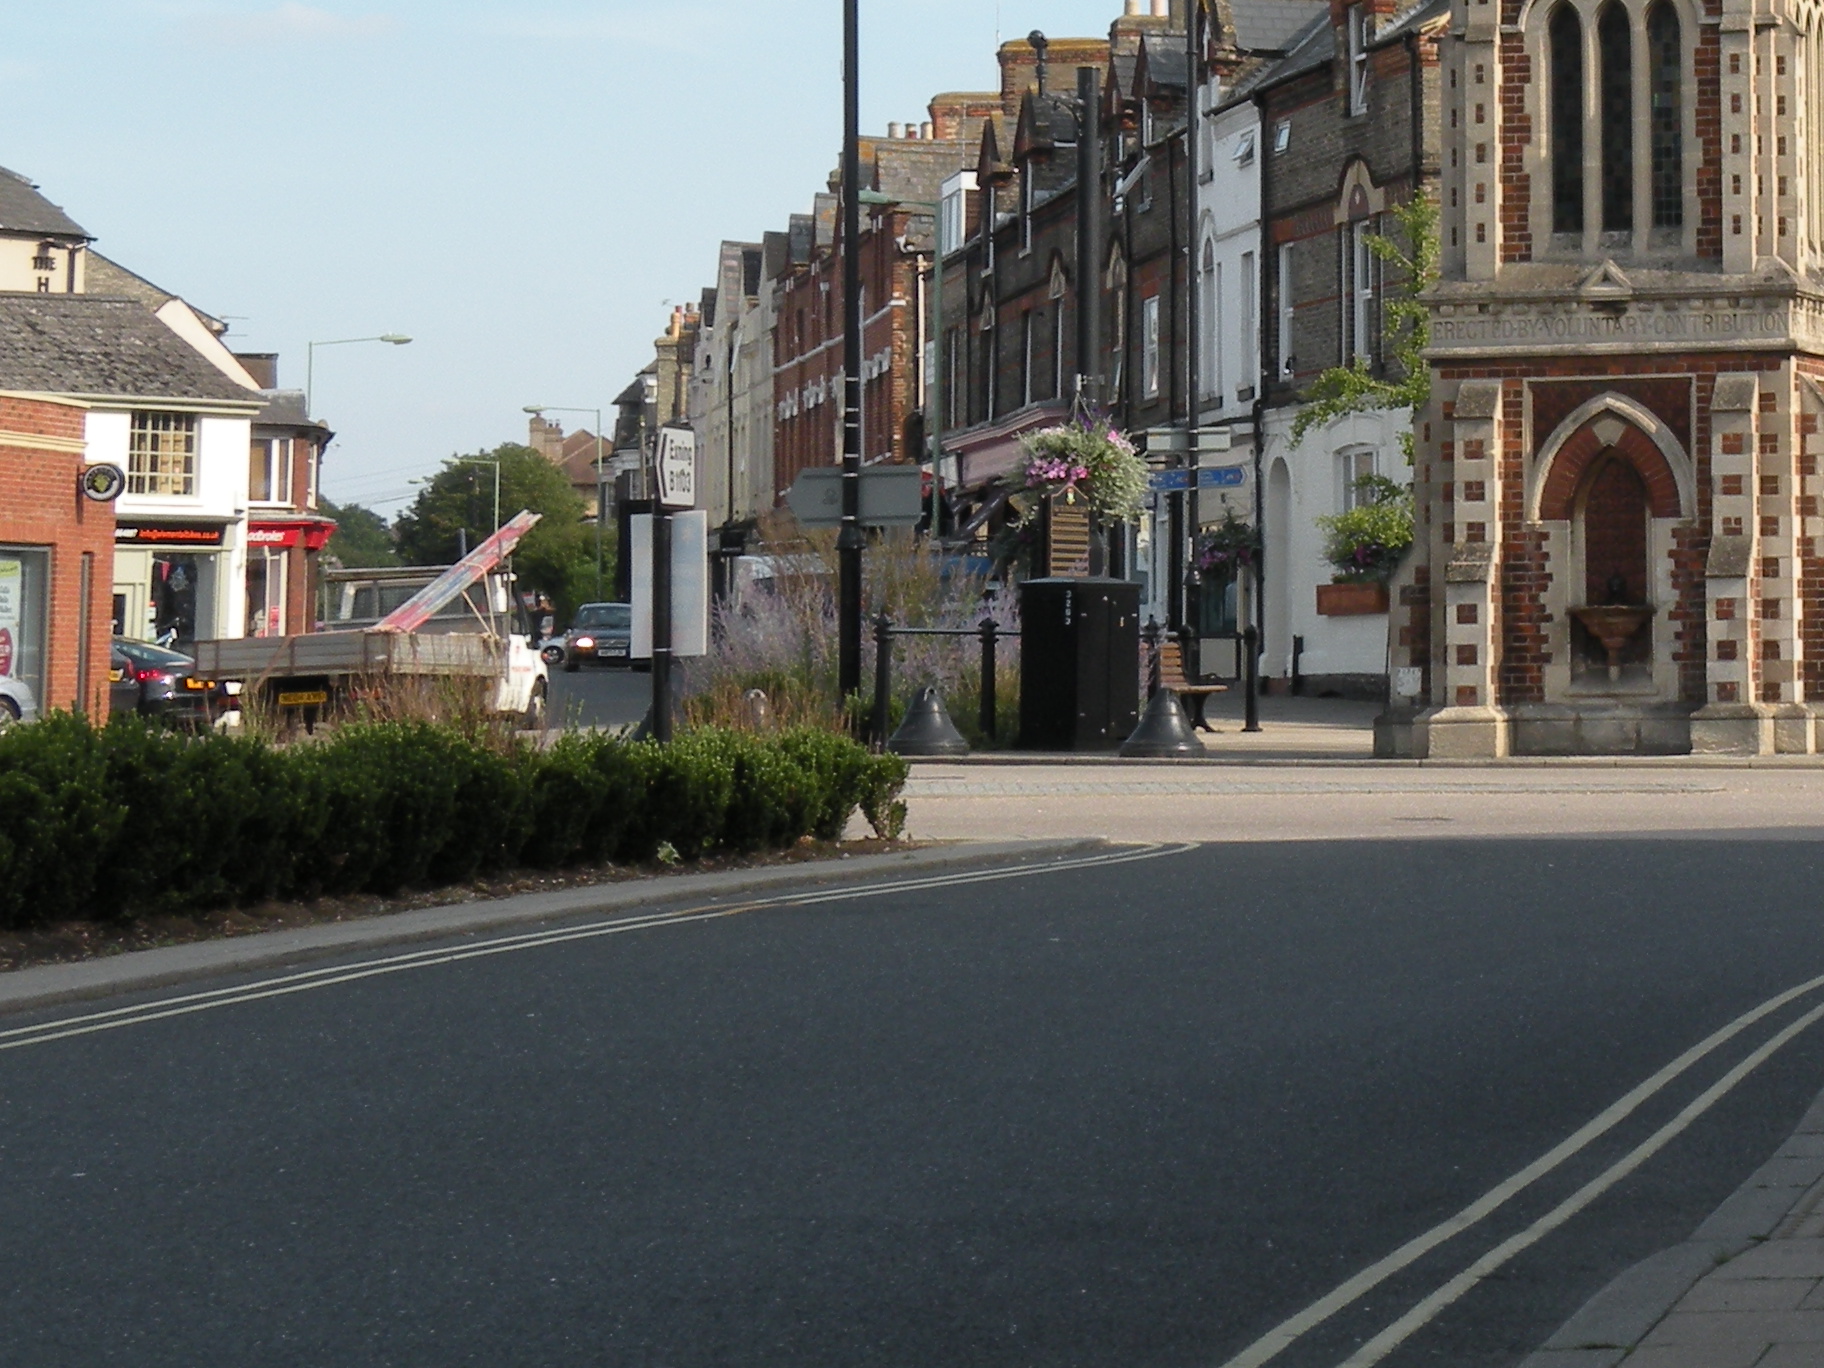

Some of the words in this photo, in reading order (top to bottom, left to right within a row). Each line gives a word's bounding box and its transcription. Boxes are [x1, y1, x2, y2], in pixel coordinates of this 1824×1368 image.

[31, 256, 56, 271] THE
[1433, 319, 1513, 340] ERECTED
[1518, 318, 1537, 338] BY
[1542, 315, 1649, 337] VOLUNTARY
[1653, 311, 1789, 335] CONTRIBUTION
[670, 439, 692, 466] Exning
